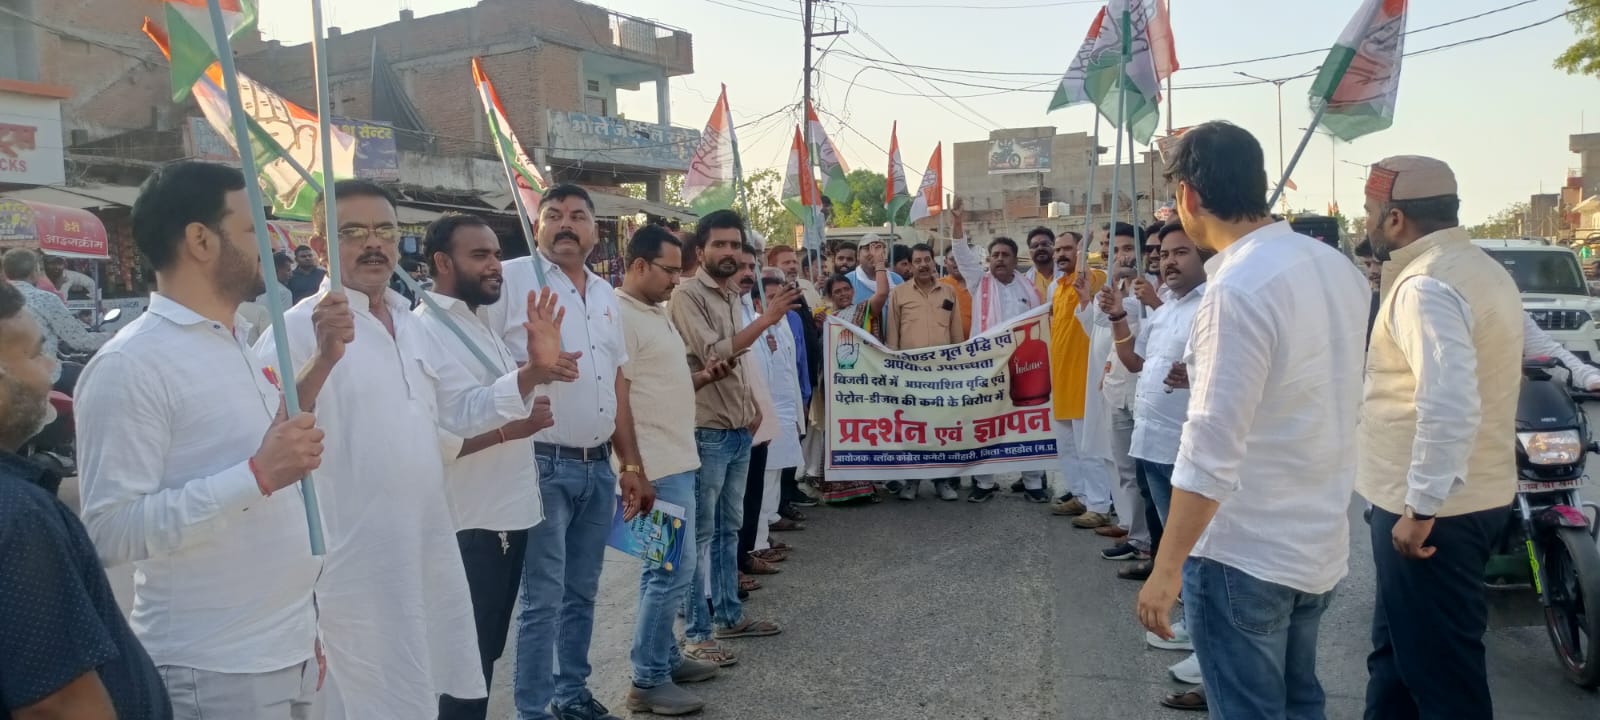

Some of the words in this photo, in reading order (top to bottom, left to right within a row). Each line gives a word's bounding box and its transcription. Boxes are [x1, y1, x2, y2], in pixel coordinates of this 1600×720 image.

[904, 378, 963, 390] अप्रत्याशित
[966, 376, 989, 392] वृद्धि
[901, 394, 917, 406] की
[919, 399, 944, 407] कमी
[962, 395, 992, 407] विरोध
[838, 409, 927, 447] प्रदर्शन
[934, 421, 963, 446] एवं
[973, 407, 1051, 443] ज्ञापन
